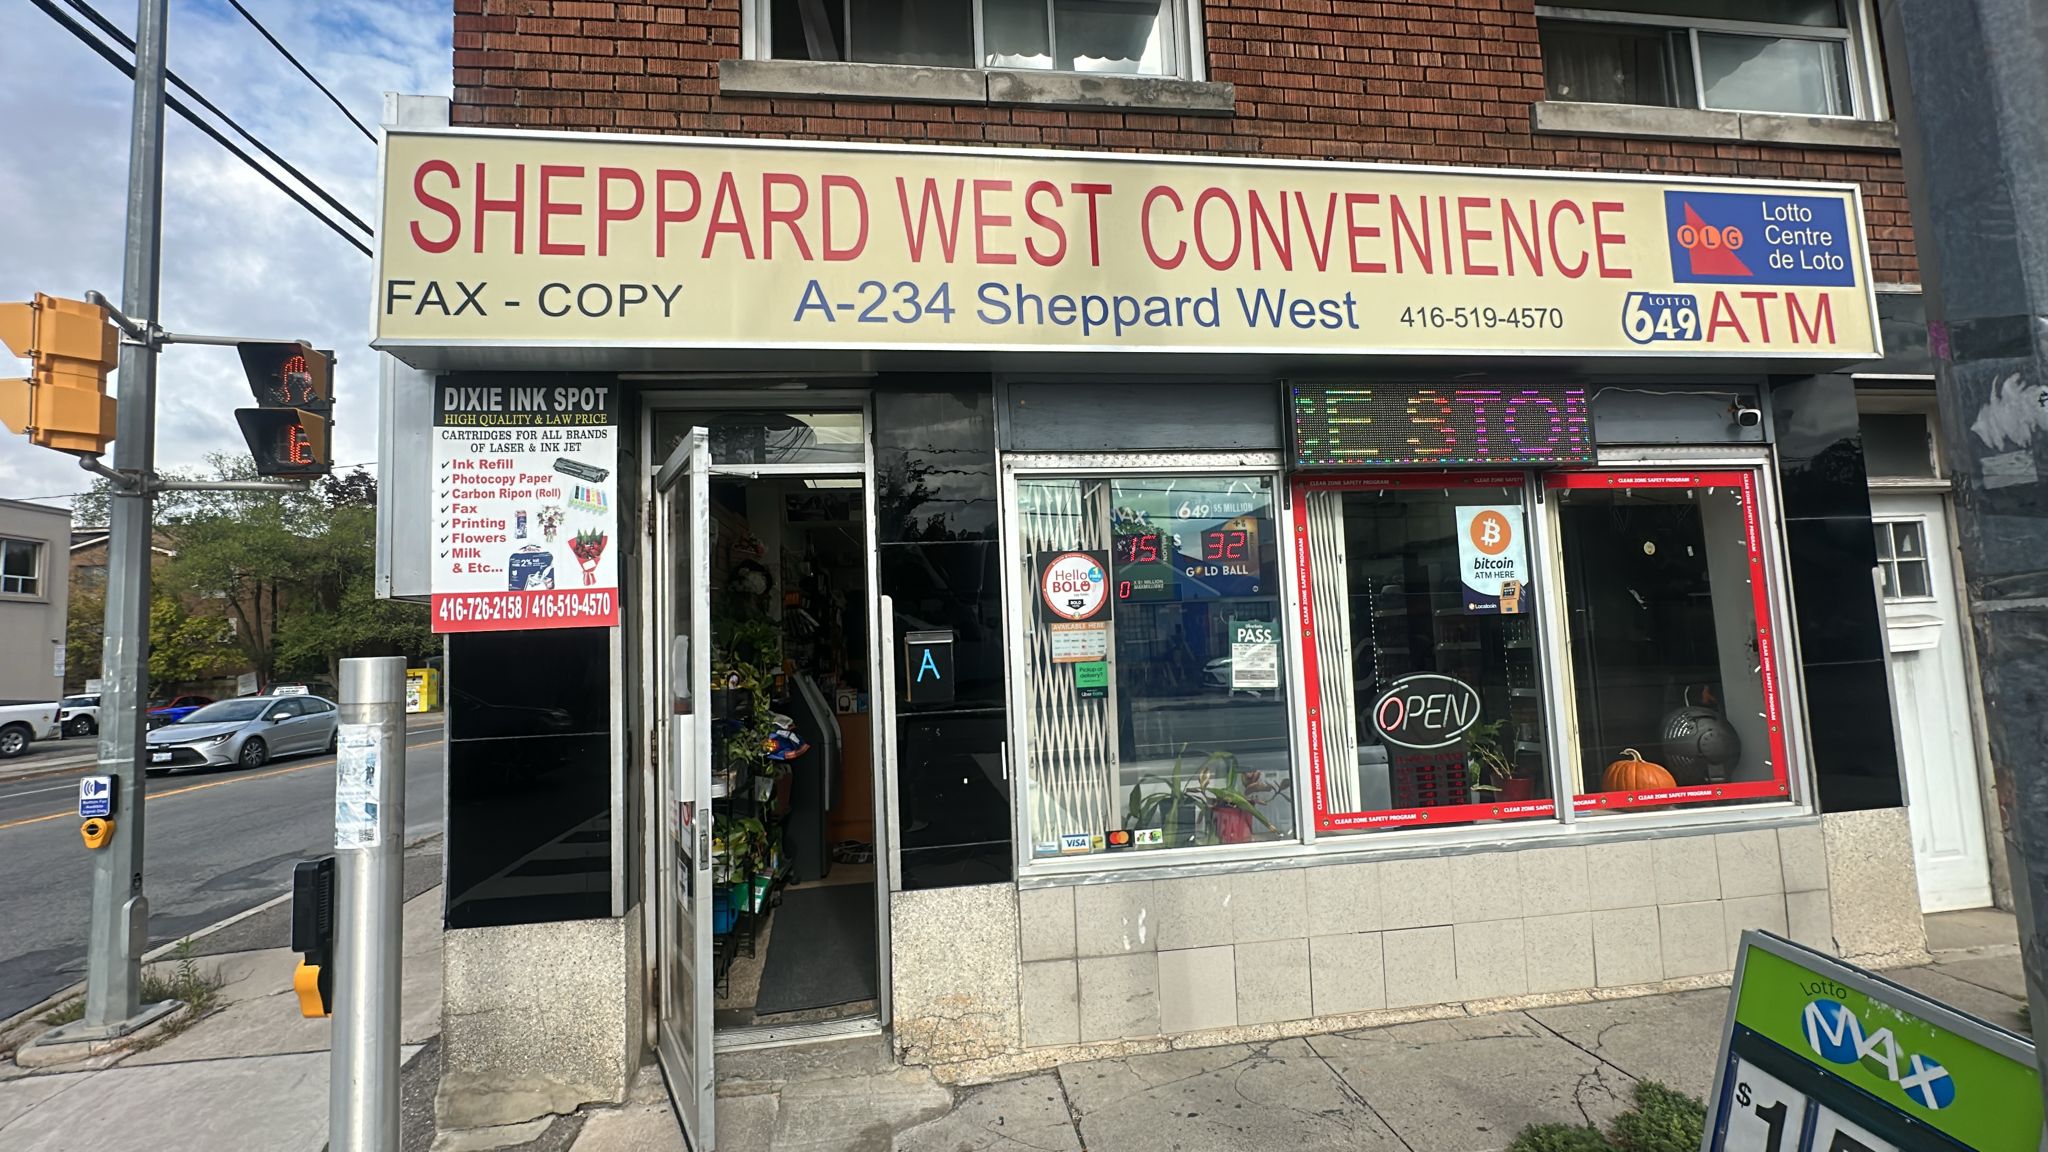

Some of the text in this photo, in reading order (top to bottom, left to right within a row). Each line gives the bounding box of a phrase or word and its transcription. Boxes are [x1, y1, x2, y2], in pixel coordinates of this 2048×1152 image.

[410, 159, 1634, 279] SHEPPARD WEST CONVENIENCE
[1762, 201, 1813, 222] Lotto
[1680, 227, 1740, 248] OLG
[1765, 225, 1832, 246] Centre
[1769, 249, 1844, 271] de Loto
[386, 280, 488, 316] FAX
[538, 282, 684, 317] COPY
[1649, 297, 1691, 307] LOTTO
[793, 280, 1360, 336] A-234 Sheppard West
[1400, 306, 1564, 330] 416-519-4570
[1625, 294, 1697, 341] 649
[1706, 291, 1836, 344] ATM
[444, 387, 608, 411] DIXIE INK SPOT
[444, 413, 608, 426] HIGH QUALITY & LAW PRICE
[441, 429, 608, 440] CARTRIDGES FOR ALL BRANDS
[470, 442, 582, 453] OF LASER & INK JET
[452, 459, 513, 469] Ink Refill
[452, 473, 553, 486] Photocopy Paper
[452, 487, 561, 500] Carbon Ripon (Roll)
[452, 503, 477, 513] Fax
[1178, 501, 1210, 518] 649
[1223, 503, 1254, 512] MILLION
[452, 518, 506, 530] Printing
[452, 533, 506, 543] Flowers
[1207, 531, 1246, 559] 32
[452, 548, 481, 558] Milk
[1130, 535, 1157, 562] 15
[452, 563, 463, 573] &
[468, 562, 503, 573] Etc...
[1222, 564, 1248, 576] BALL
[1474, 556, 1514, 570] bitcoin
[1055, 569, 1087, 580] Hello
[1474, 570, 1515, 579] ATM HERE
[1053, 581, 1091, 593] BOLO
[439, 596, 522, 621] 416-726-2158
[532, 592, 610, 618] 416-519-4570
[1237, 628, 1272, 643] PASS
[916, 649, 941, 683] A
[1379, 692, 1470, 731] OPEN
[1066, 838, 1086, 848] VISA
[1800, 981, 1847, 1000] Lotto
[1803, 1001, 1950, 1111] MAX
[1736, 1082, 1752, 1109] $
